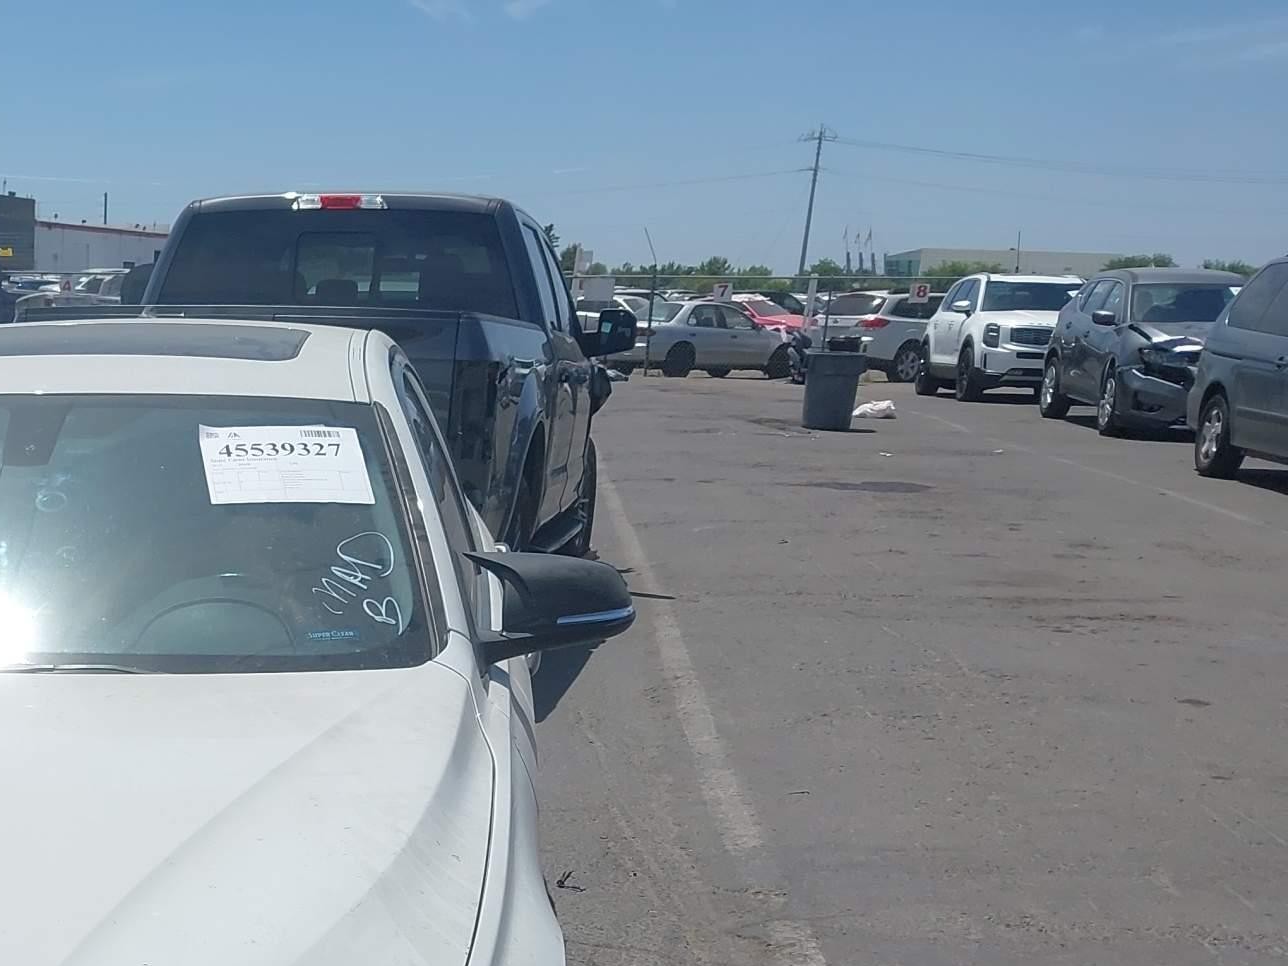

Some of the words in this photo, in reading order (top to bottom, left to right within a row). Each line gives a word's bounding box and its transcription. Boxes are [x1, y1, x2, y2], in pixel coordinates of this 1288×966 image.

[718, 284, 729, 297] 7
[916, 285, 927, 298] 8
[218, 442, 341, 458] 45539327
